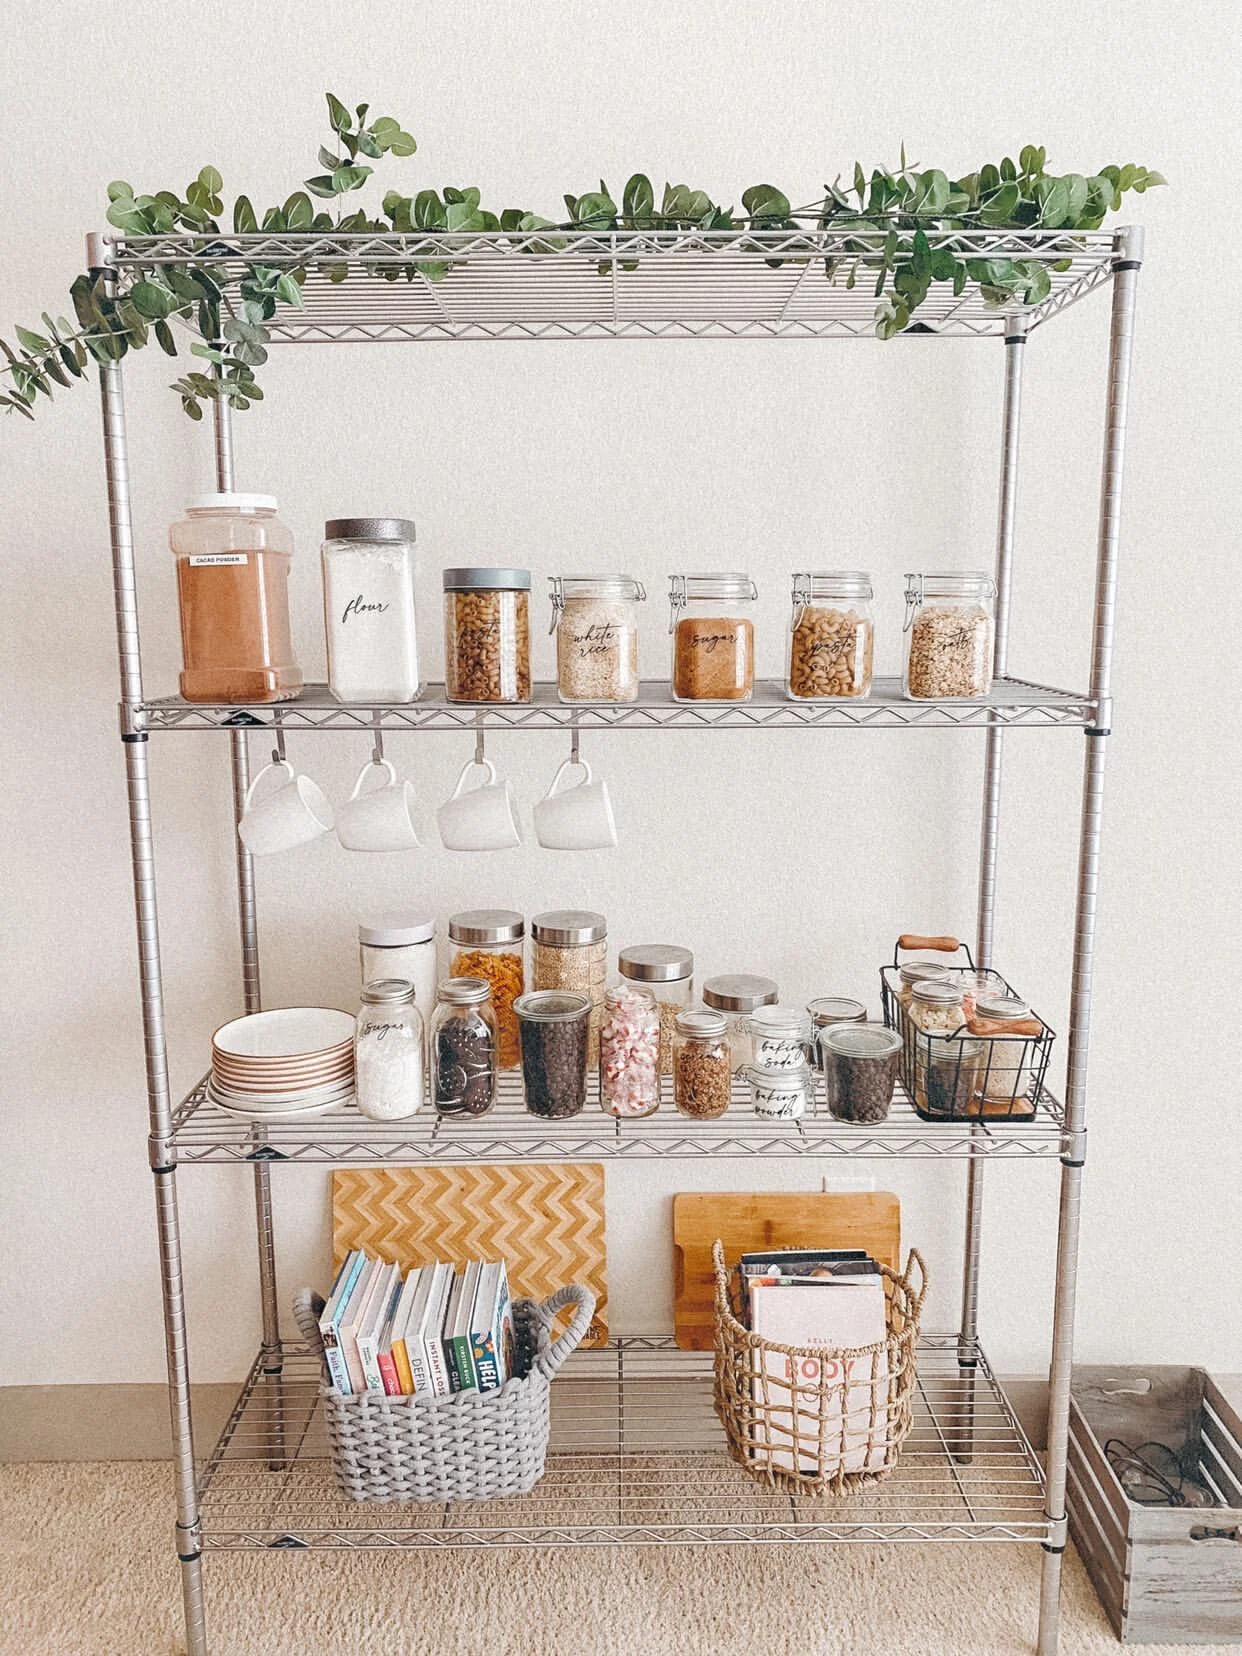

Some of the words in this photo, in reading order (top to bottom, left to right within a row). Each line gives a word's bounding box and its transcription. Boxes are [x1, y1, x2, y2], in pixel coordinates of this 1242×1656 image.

[342, 594, 391, 624] flour
[573, 622, 622, 644] white
[691, 634, 738, 653] sugar
[579, 645, 611, 657] rice
[807, 633, 861, 658] pasta
[364, 1022, 404, 1040] sugar
[761, 1040, 804, 1060] baking
[764, 1053, 792, 1069] soda
[755, 1088, 799, 1110] baking
[754, 1103, 794, 1118] powder
[411, 1358, 428, 1392] DEFIN
[429, 1341, 442, 1374] INSTANT
[436, 1375, 447, 1397] LOSS
[478, 1360, 497, 1390] HELP
